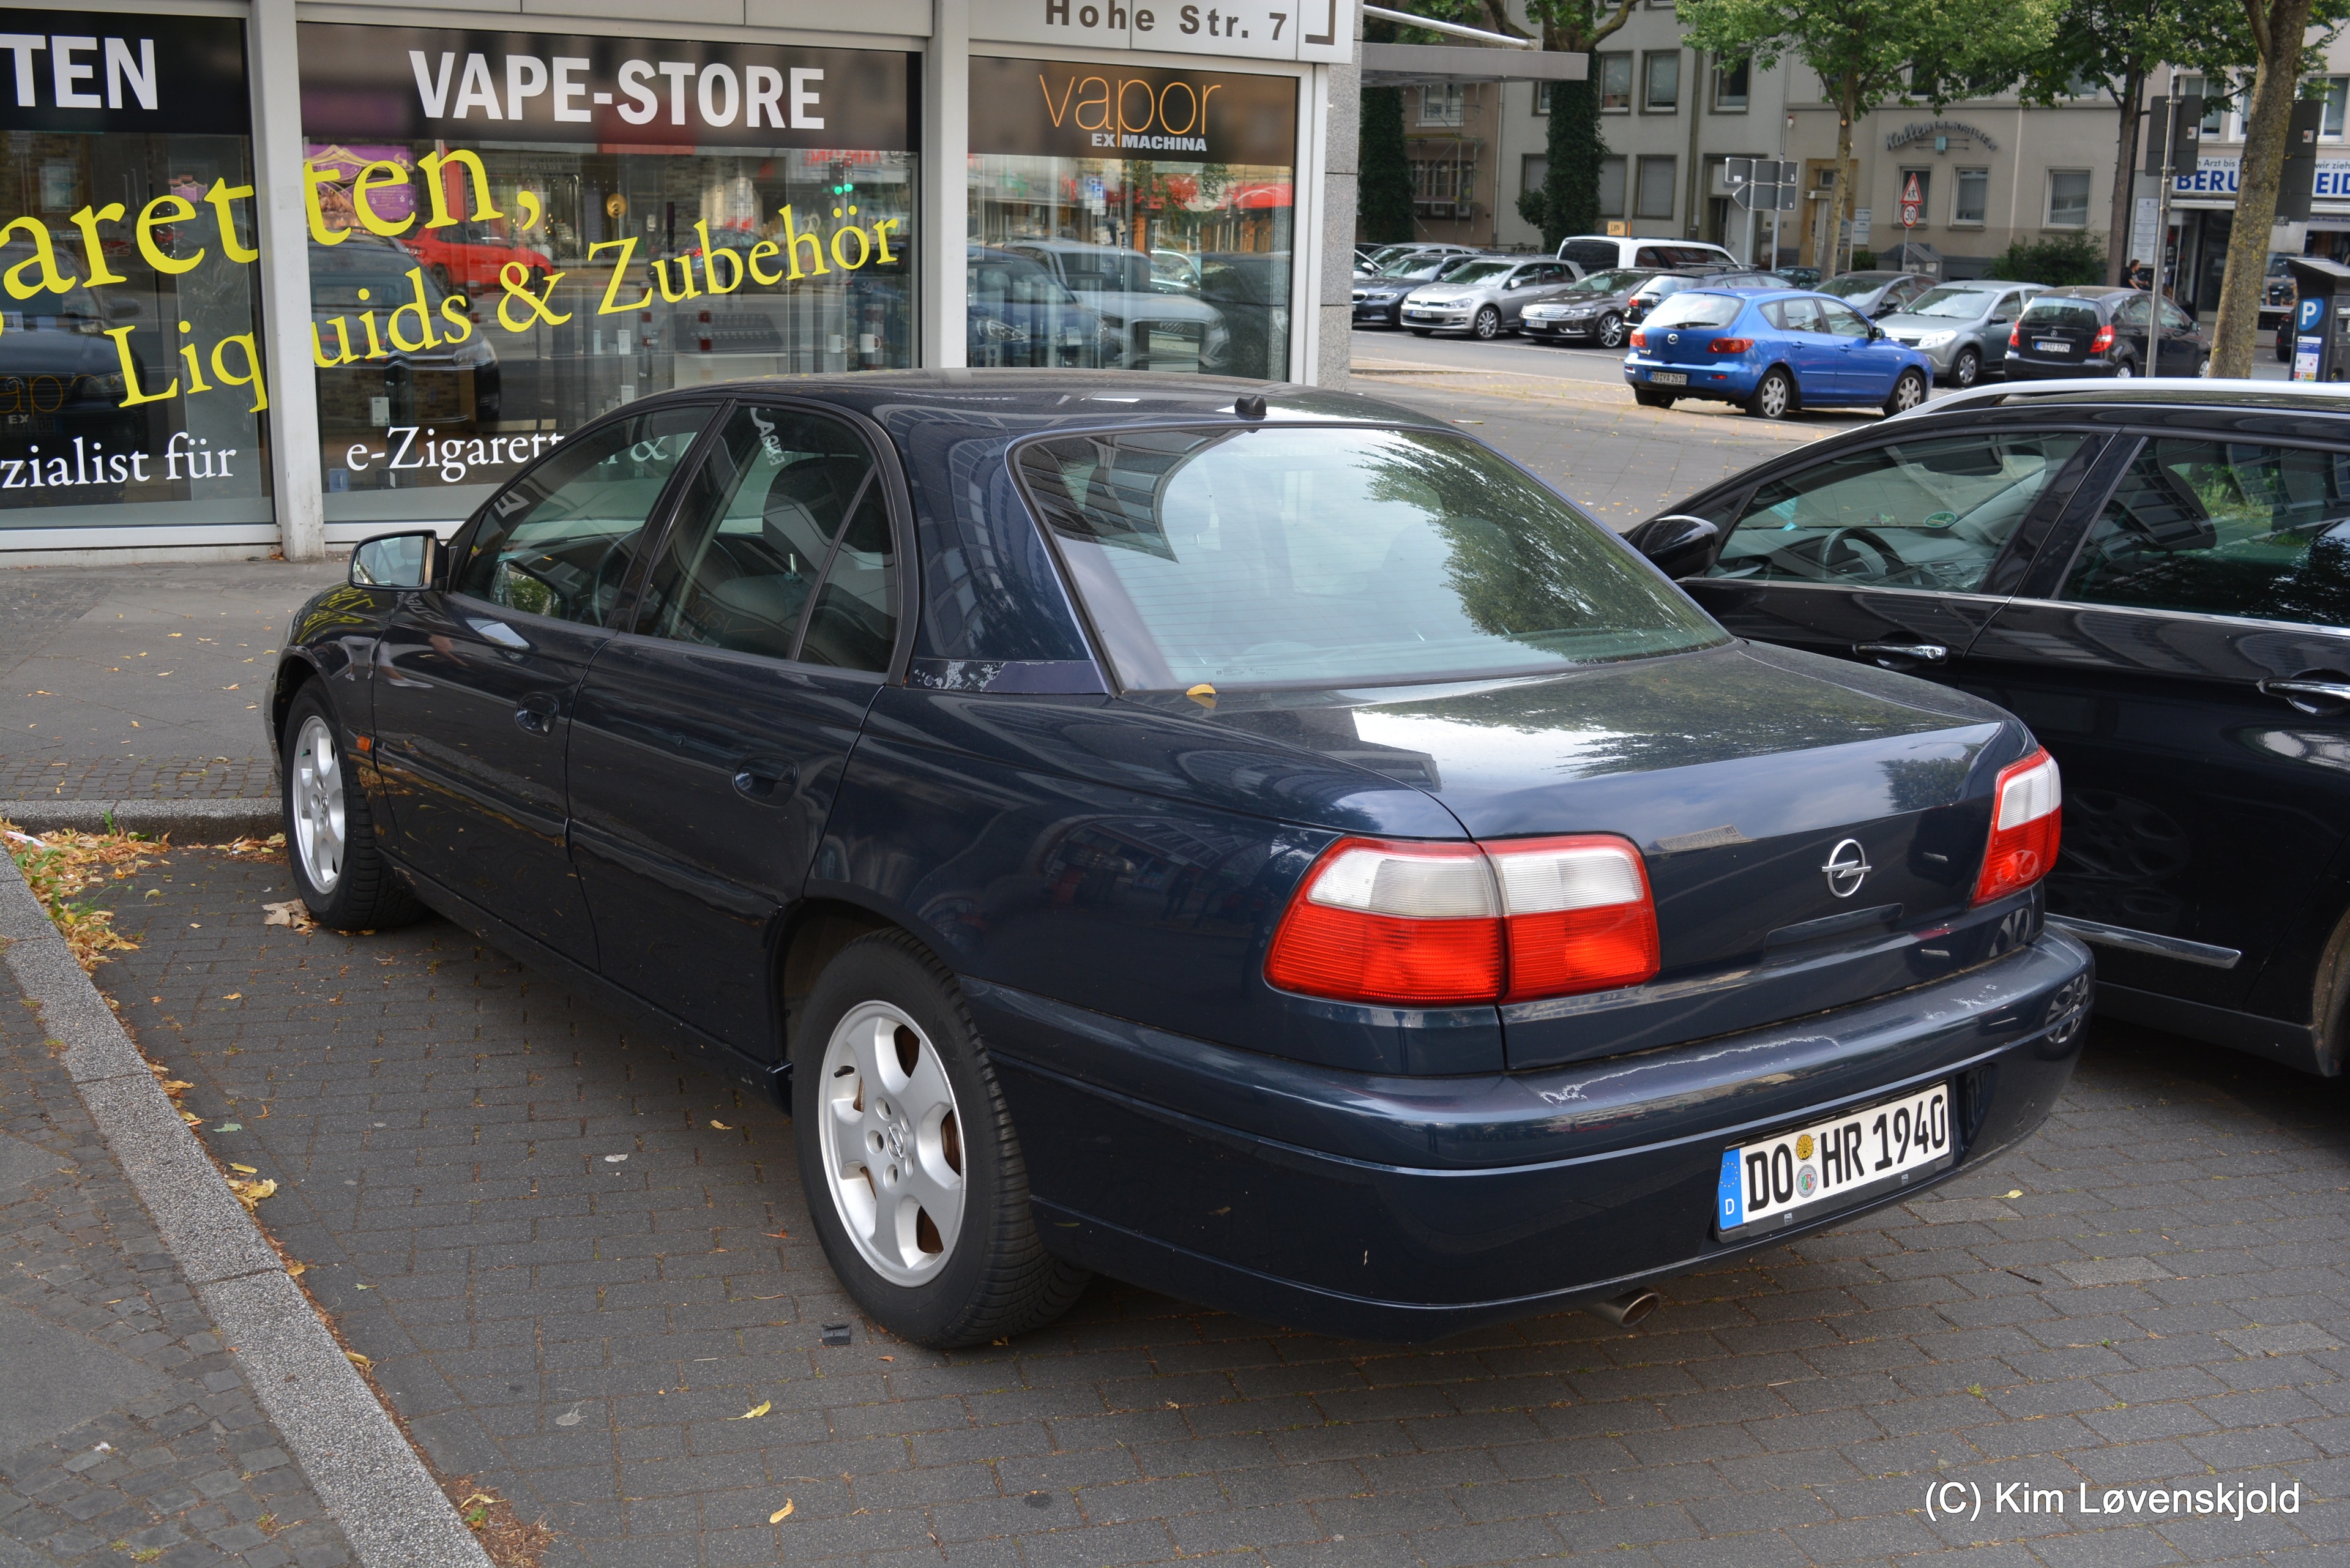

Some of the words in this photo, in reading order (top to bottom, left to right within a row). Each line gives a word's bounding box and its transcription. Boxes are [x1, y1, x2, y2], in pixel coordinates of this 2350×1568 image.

[1045, 0, 1155, 32] Hohe
[1179, 5, 1248, 38] Str.
[1269, 12, 1286, 40] 7
[408, 50, 825, 130] VAPE-STORE
[1039, 74, 1222, 147] vapor
[1091, 133, 1116, 147] EX
[1121, 134, 1207, 152] MACHINA
[2204, 159, 2221, 167] Arzt
[1904, 209, 1915, 221] 30
[497, 261, 572, 333] &
[588, 204, 898, 315] Zubehör
[2302, 301, 2317, 326] P
[1671, 375, 1686, 383] 2610
[1, 435, 151, 489] zialist
[165, 431, 237, 480] für
[1745, 1143, 1794, 1212] DO
[1820, 1121, 1865, 1189] HR
[1873, 1094, 1946, 1171] 1940
[1725, 1197, 1736, 1216] D
